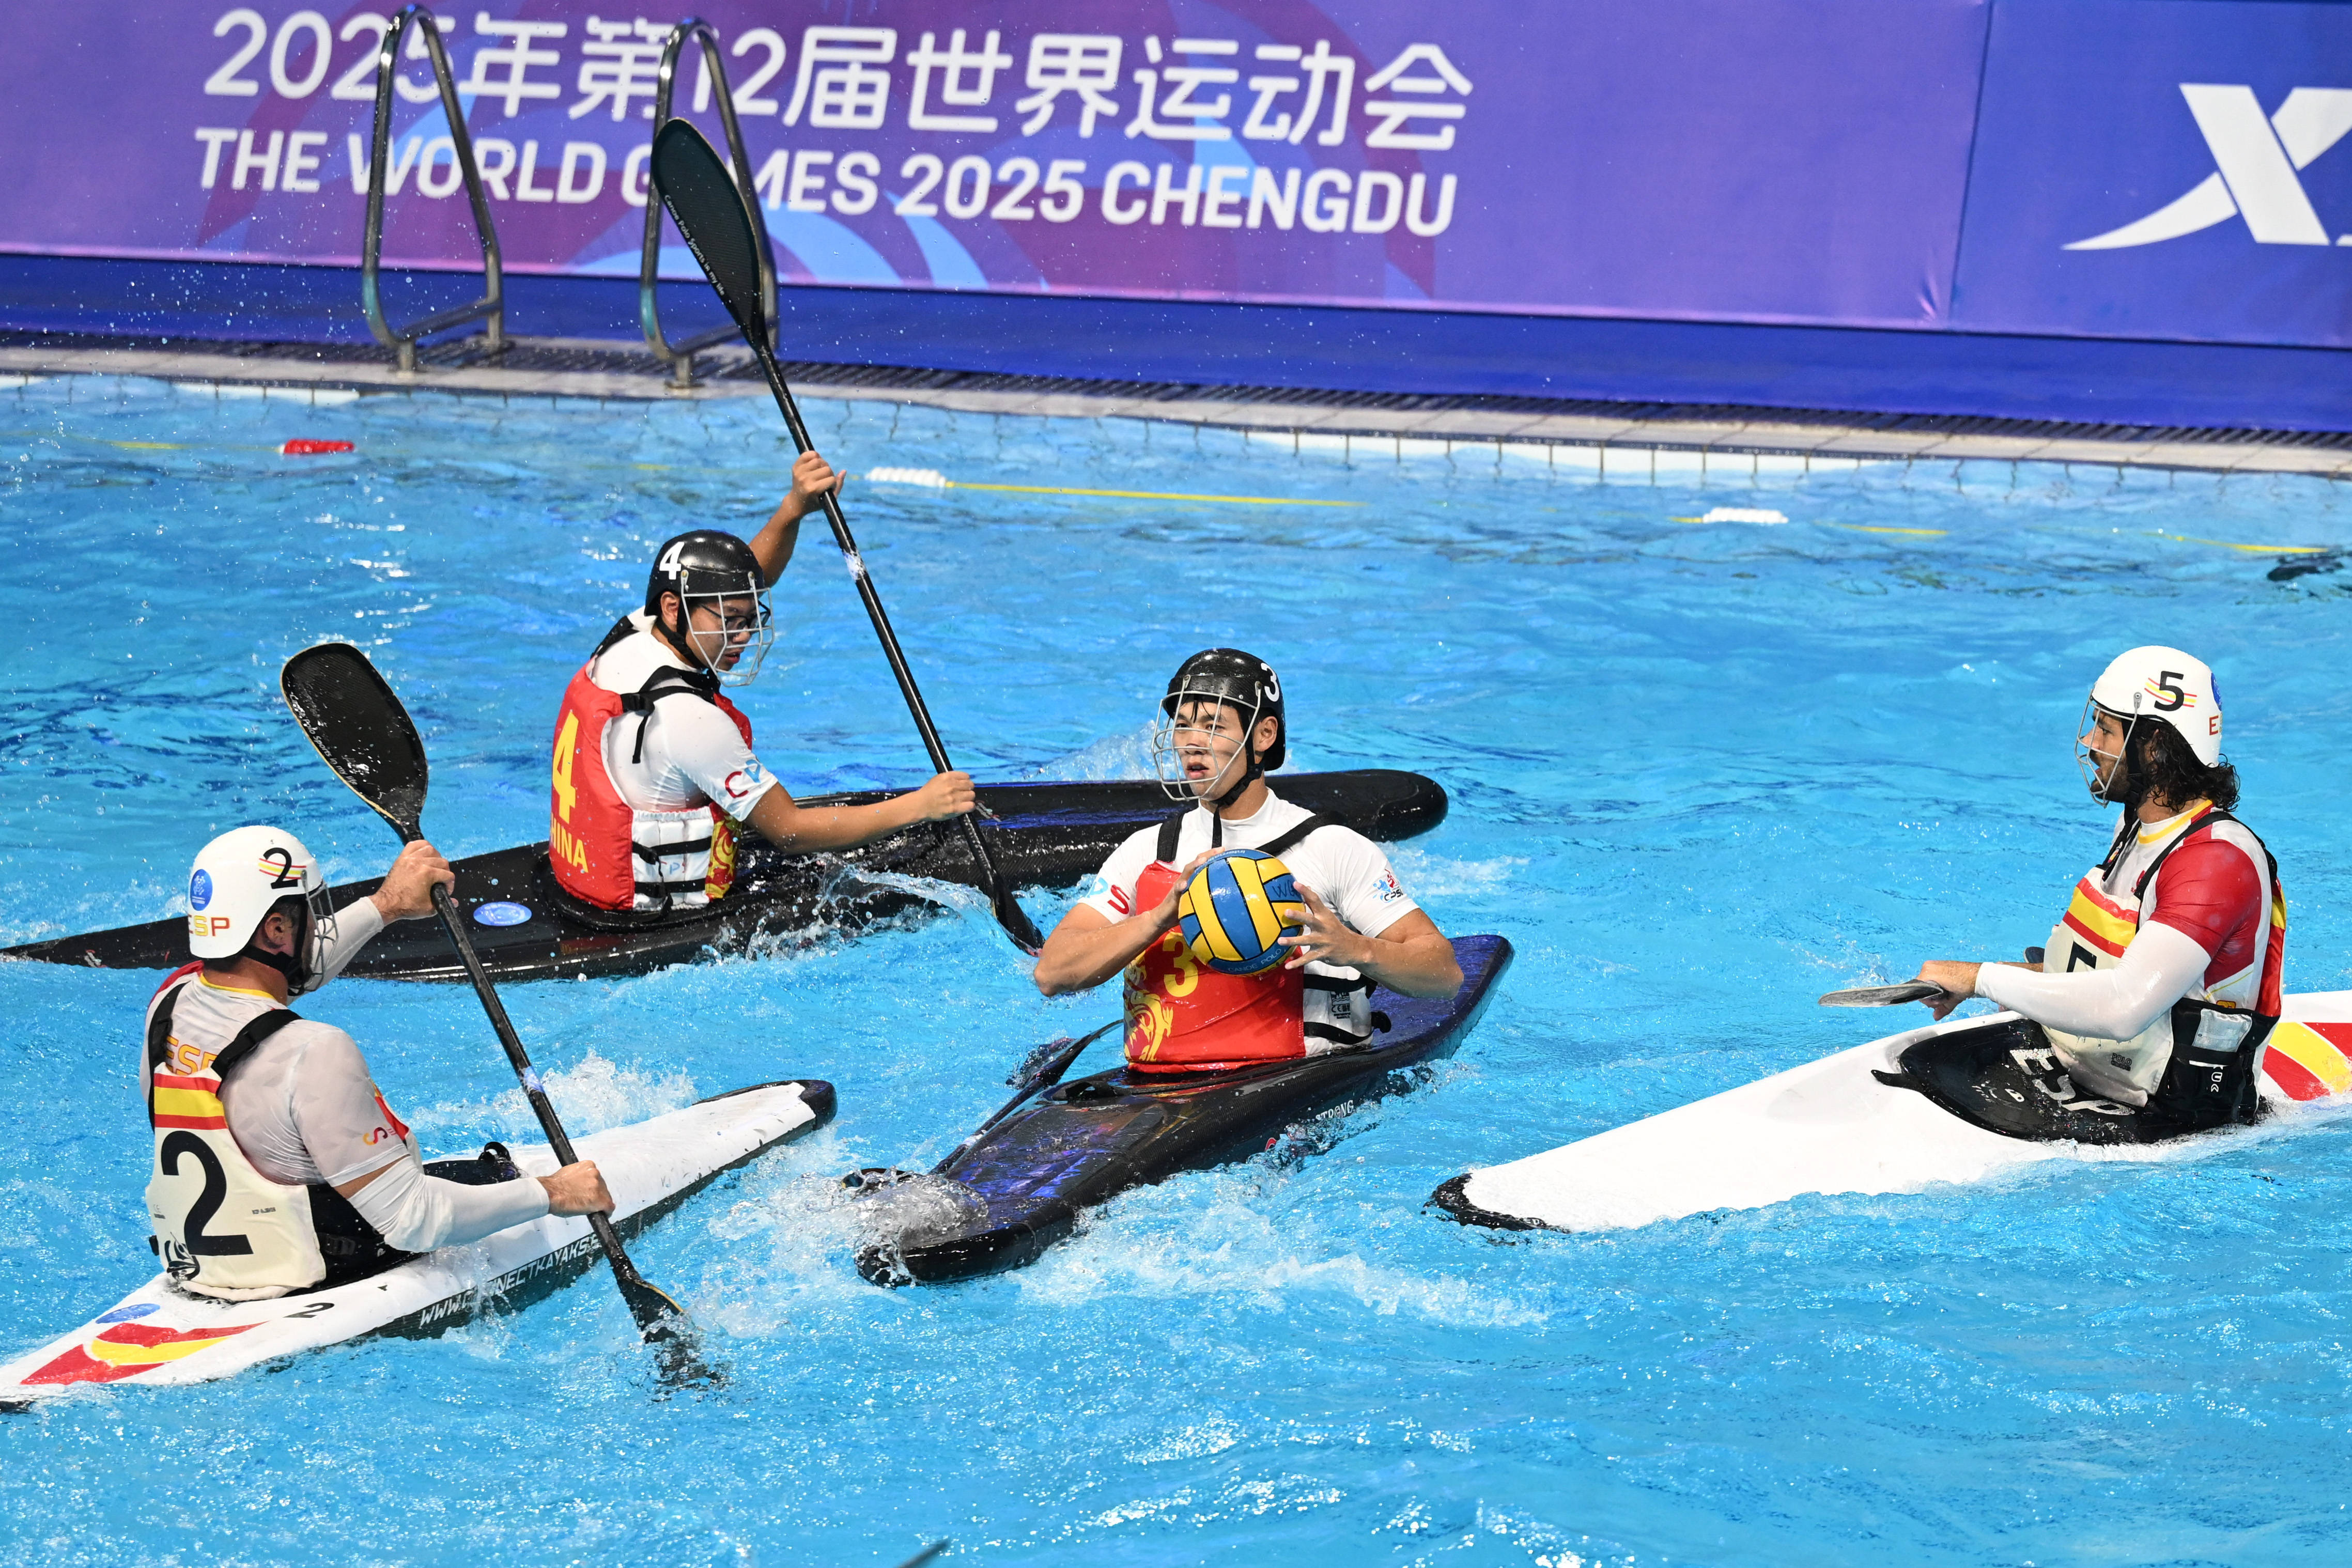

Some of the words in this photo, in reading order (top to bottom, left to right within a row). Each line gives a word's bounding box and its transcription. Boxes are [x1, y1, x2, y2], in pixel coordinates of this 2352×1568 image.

[195, 128, 327, 192] THE
[347, 133, 607, 203] WORLD
[621, 143, 880, 214] GMES
[894, 154, 1086, 222] 2025
[1101, 161, 1457, 237] CHENGDU
[678, 221, 691, 239] Polo
[688, 238, 705, 263] Sports
[709, 271, 718, 284] my
[716, 283, 725, 296] life
[659, 541, 685, 580] 4
[1260, 662, 1280, 702] 3
[2154, 671, 2185, 711] 5
[313, 735, 332, 757] Sports
[330, 757, 338, 765] in
[336, 765, 348, 775] my
[345, 775, 358, 785] life
[552, 709, 579, 825] 4
[551, 811, 589, 873] HINA
[262, 847, 299, 890] 2
[1162, 931, 1199, 998] 3
[1228, 963, 1258, 972] CANOE
[1260, 948, 1282, 965] POLO
[2111, 1052, 2132, 1066] POLO
[160, 1130, 254, 1256] 2
[282, 1302, 335, 1318] 2
